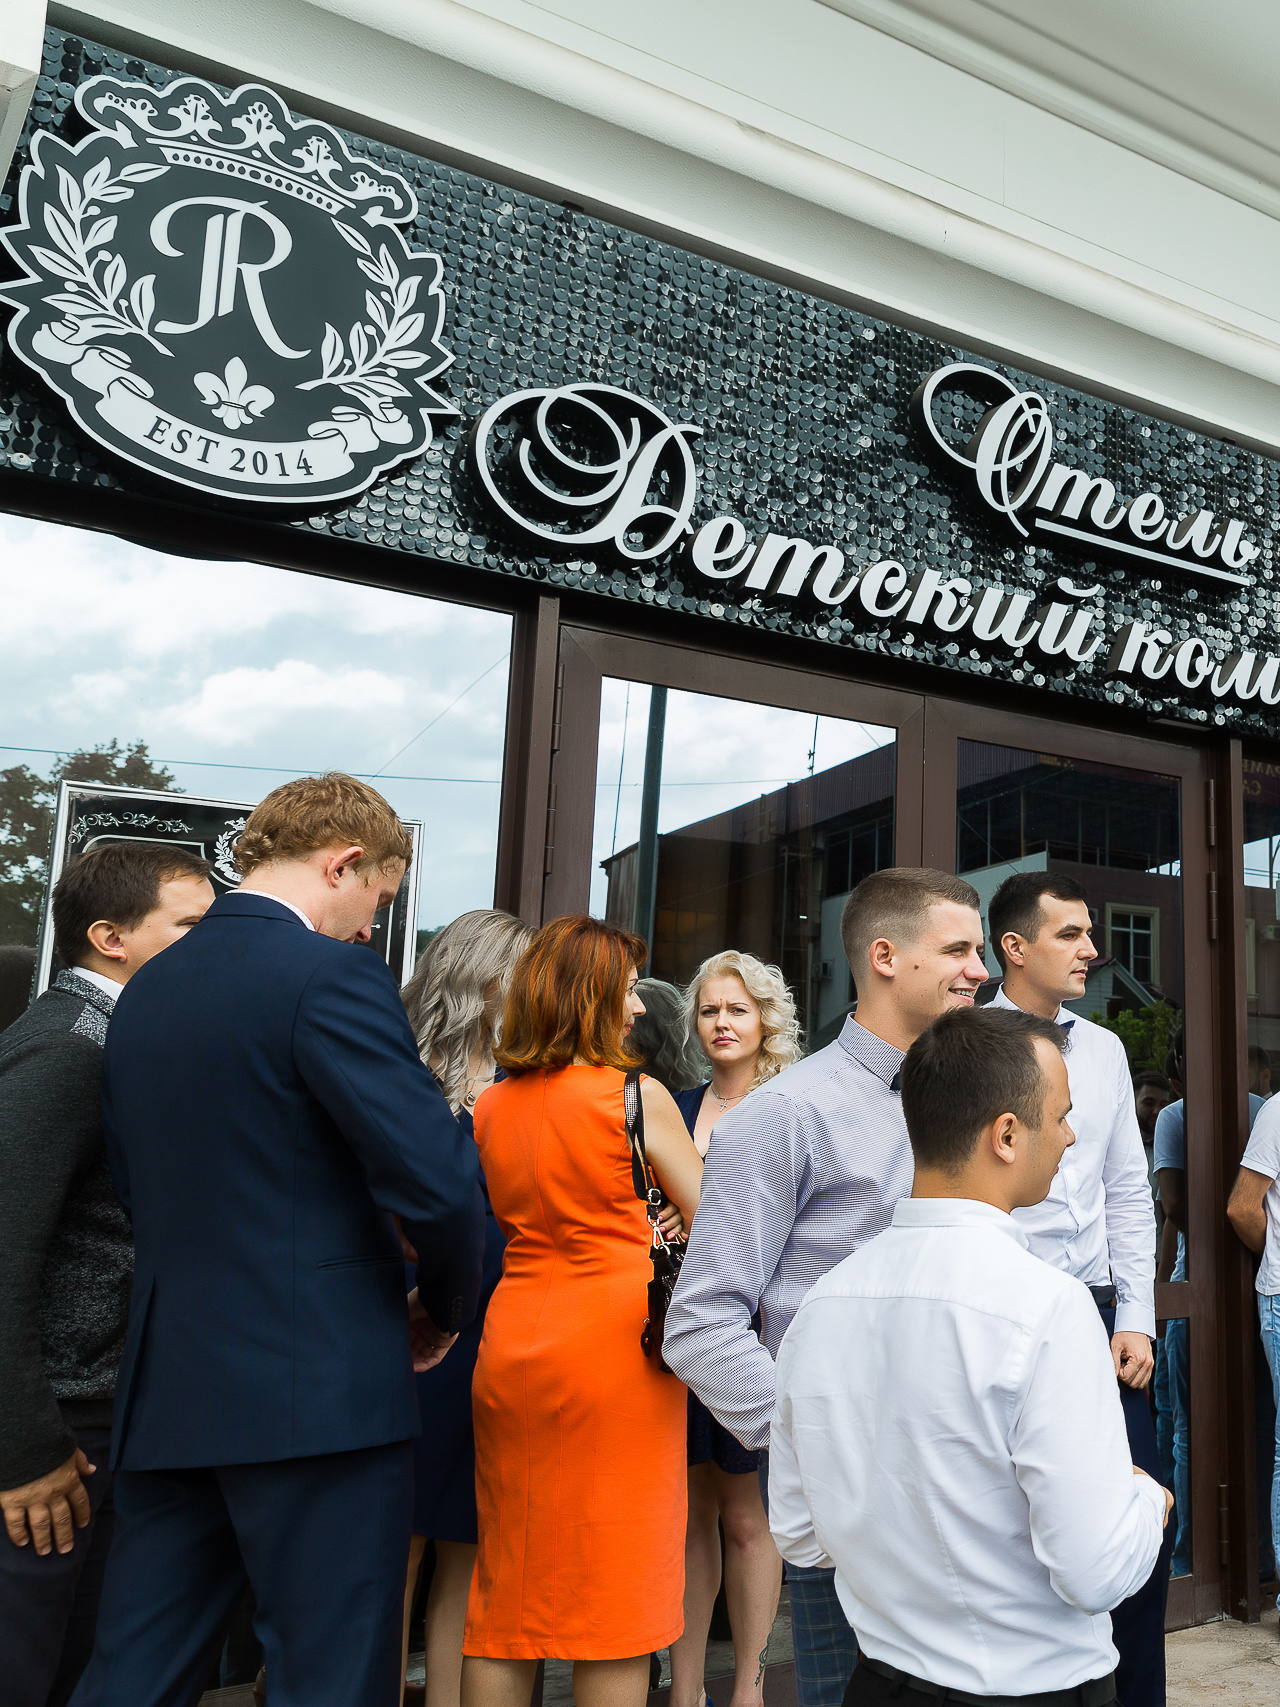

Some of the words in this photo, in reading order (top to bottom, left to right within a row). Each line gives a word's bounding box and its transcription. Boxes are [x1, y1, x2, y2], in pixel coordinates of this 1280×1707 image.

[144, 416, 219, 463] EST
[229, 449, 314, 477] 2014
[474, 382, 1103, 662] Детский
[922, 362, 1260, 570] Отель
